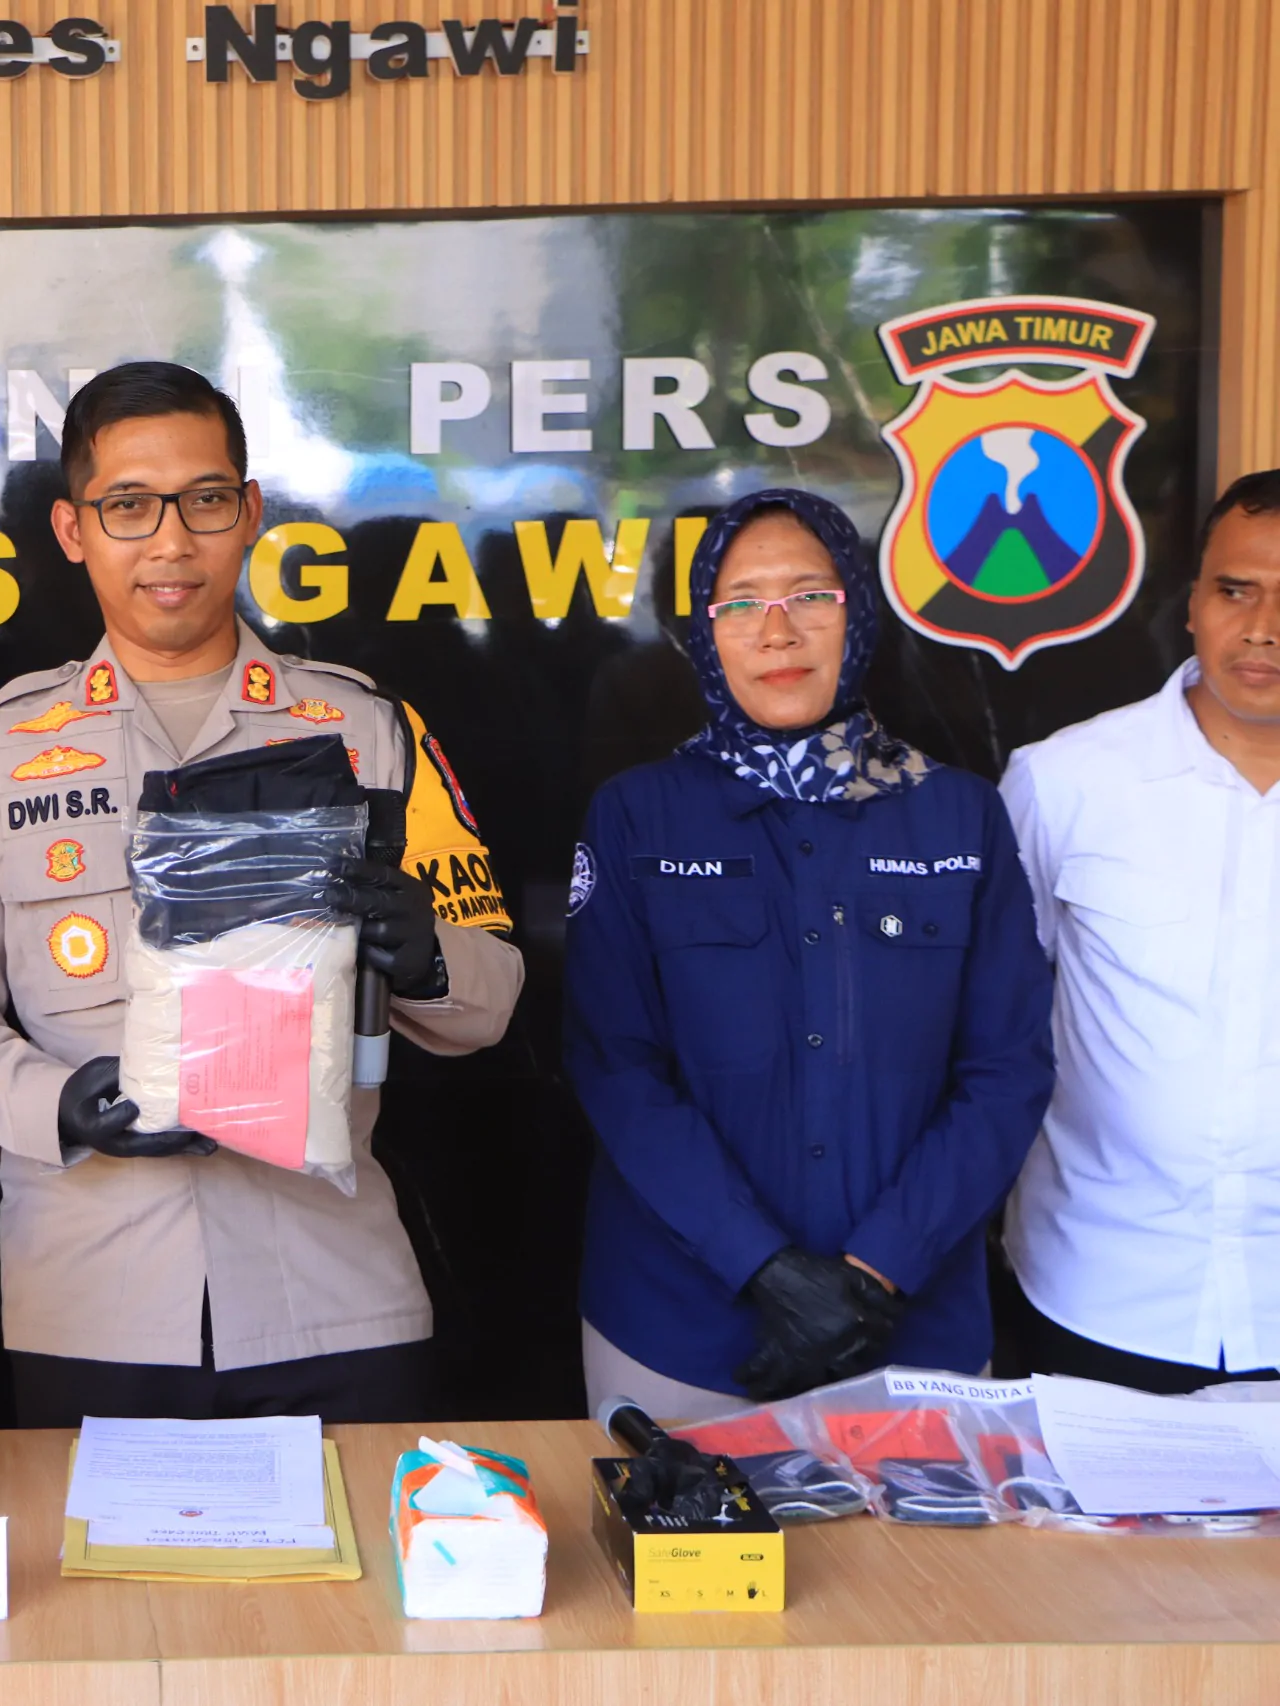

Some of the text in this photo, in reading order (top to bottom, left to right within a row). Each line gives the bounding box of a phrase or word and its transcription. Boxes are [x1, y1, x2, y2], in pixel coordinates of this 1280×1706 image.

[205, 0, 579, 101] Ngawi
[921, 316, 1114, 356] JAWA TIMUR
[409, 351, 832, 455] PERS
[248, 516, 718, 623] GAWI
[7, 787, 118, 830] DWI S.R.
[659, 860, 723, 876] DIAN
[869, 858, 928, 875] HUMAS
[433, 901, 458, 923] PS
[894, 1380, 915, 1391] BB
[920, 1381, 964, 1396] YANG
[969, 1386, 1022, 1399] DISITA
